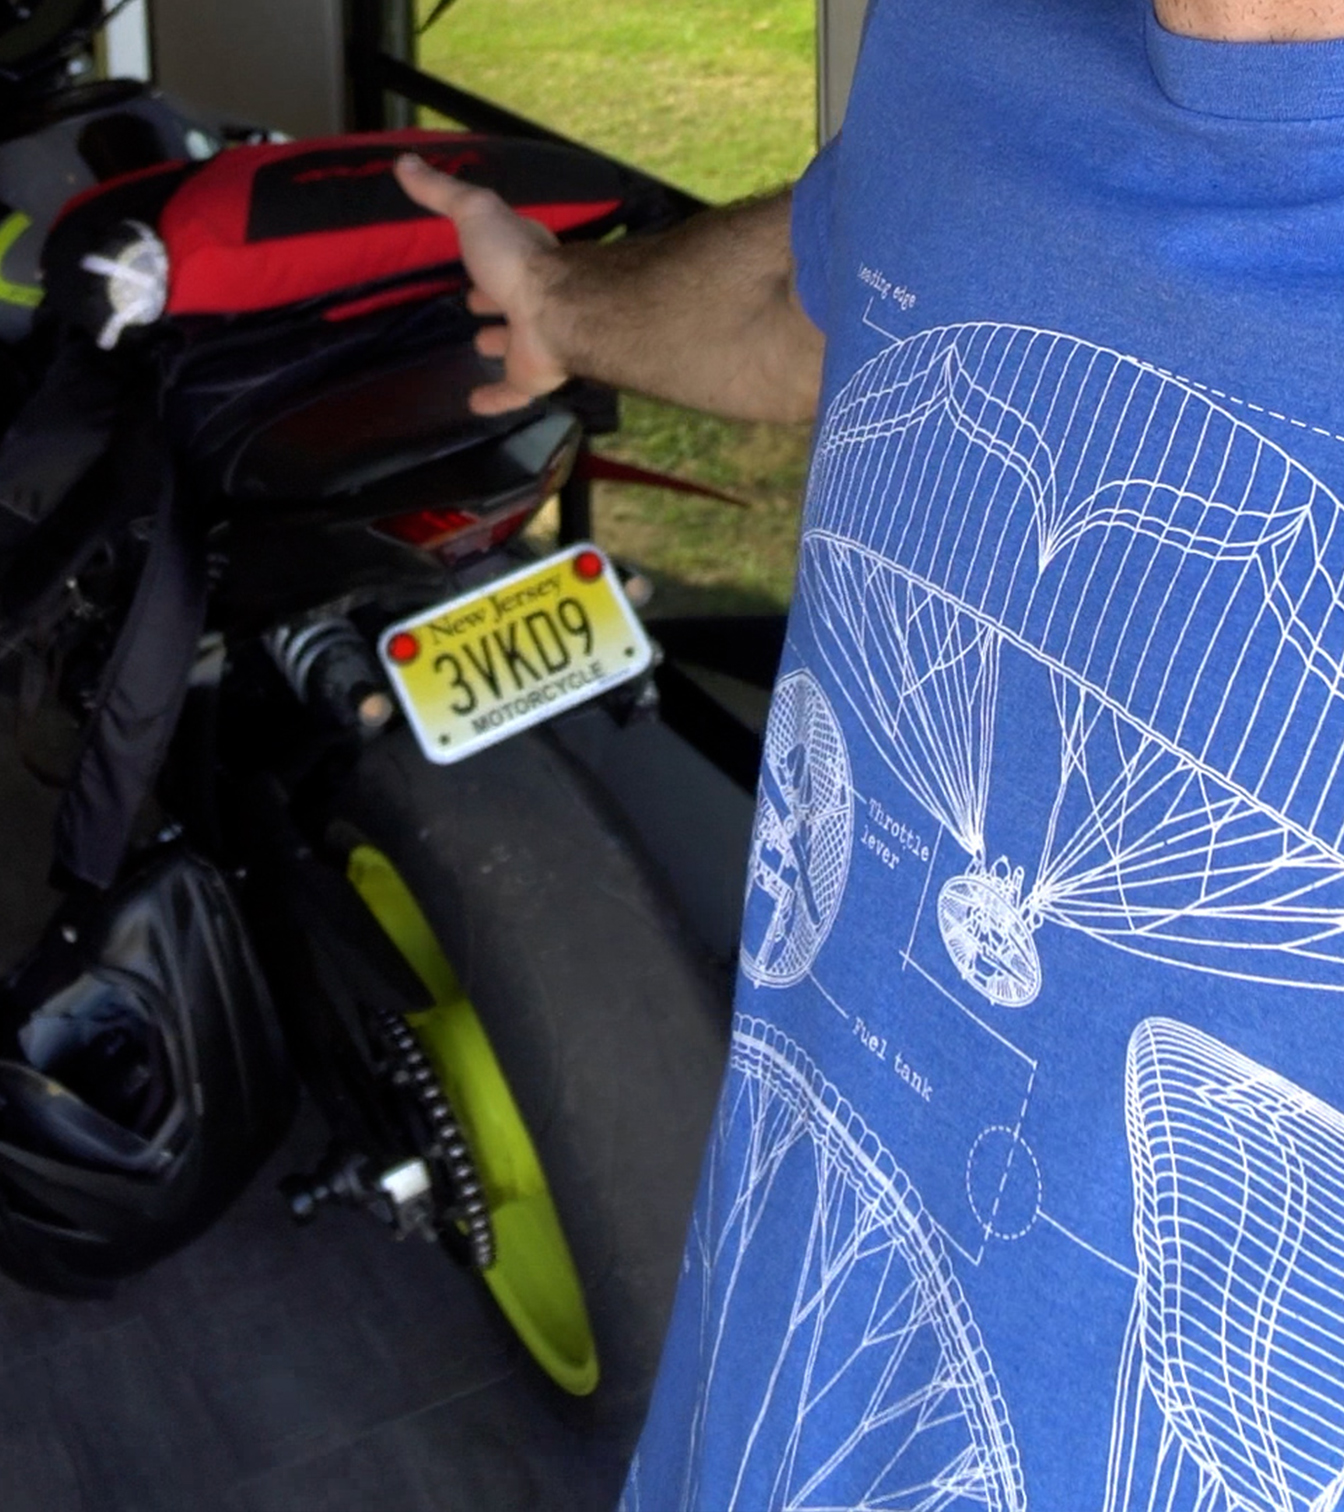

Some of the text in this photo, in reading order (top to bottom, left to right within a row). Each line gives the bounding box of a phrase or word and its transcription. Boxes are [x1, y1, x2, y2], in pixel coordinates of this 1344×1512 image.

[892, 286, 917, 311] edge
[425, 571, 564, 645] New Jersey
[433, 596, 596, 716] 3VKD9
[470, 660, 605, 734] MOTORCYCLE
[859, 823, 900, 870] lever
[868, 796, 930, 862] Throttle
[851, 1015, 934, 1103] Fuel tank
